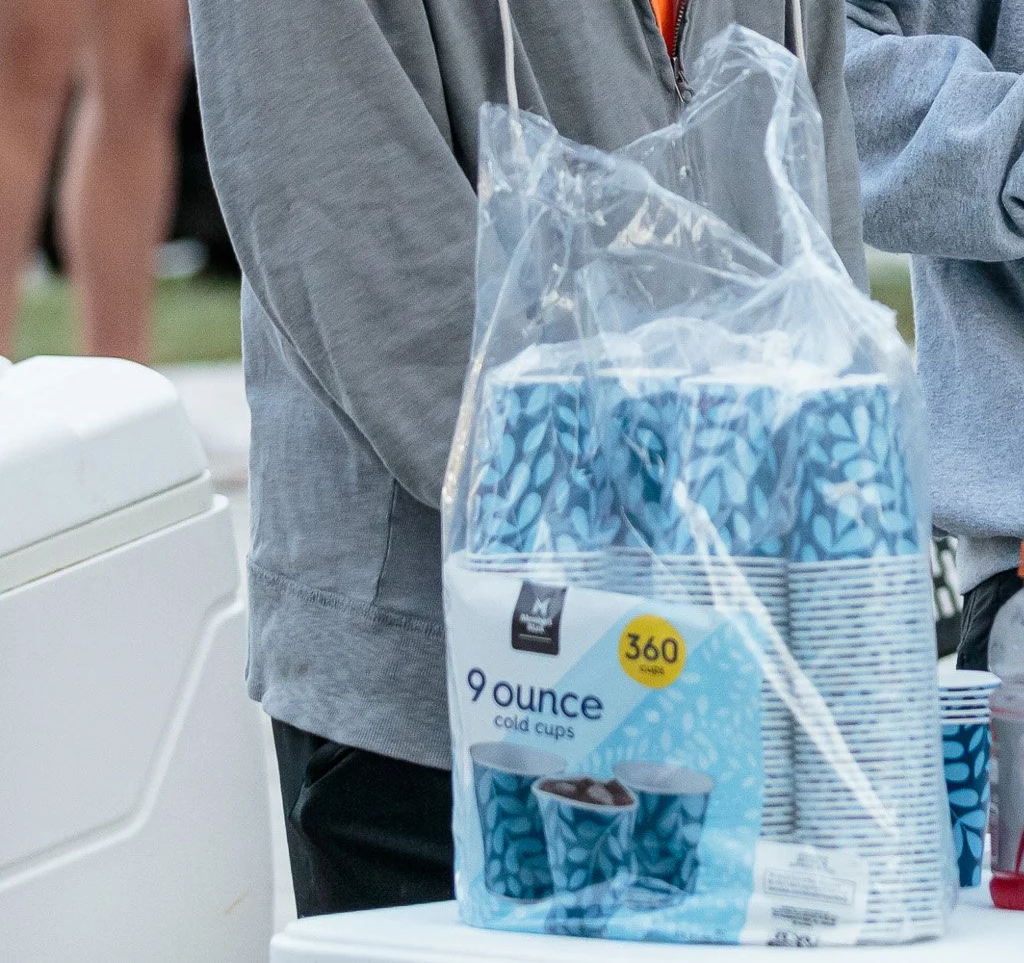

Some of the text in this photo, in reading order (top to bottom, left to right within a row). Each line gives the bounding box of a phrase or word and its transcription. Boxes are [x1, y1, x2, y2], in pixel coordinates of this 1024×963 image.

[625, 632, 679, 664] 360
[467, 667, 605, 721] 9 ounce
[494, 714, 576, 740] cold cups
